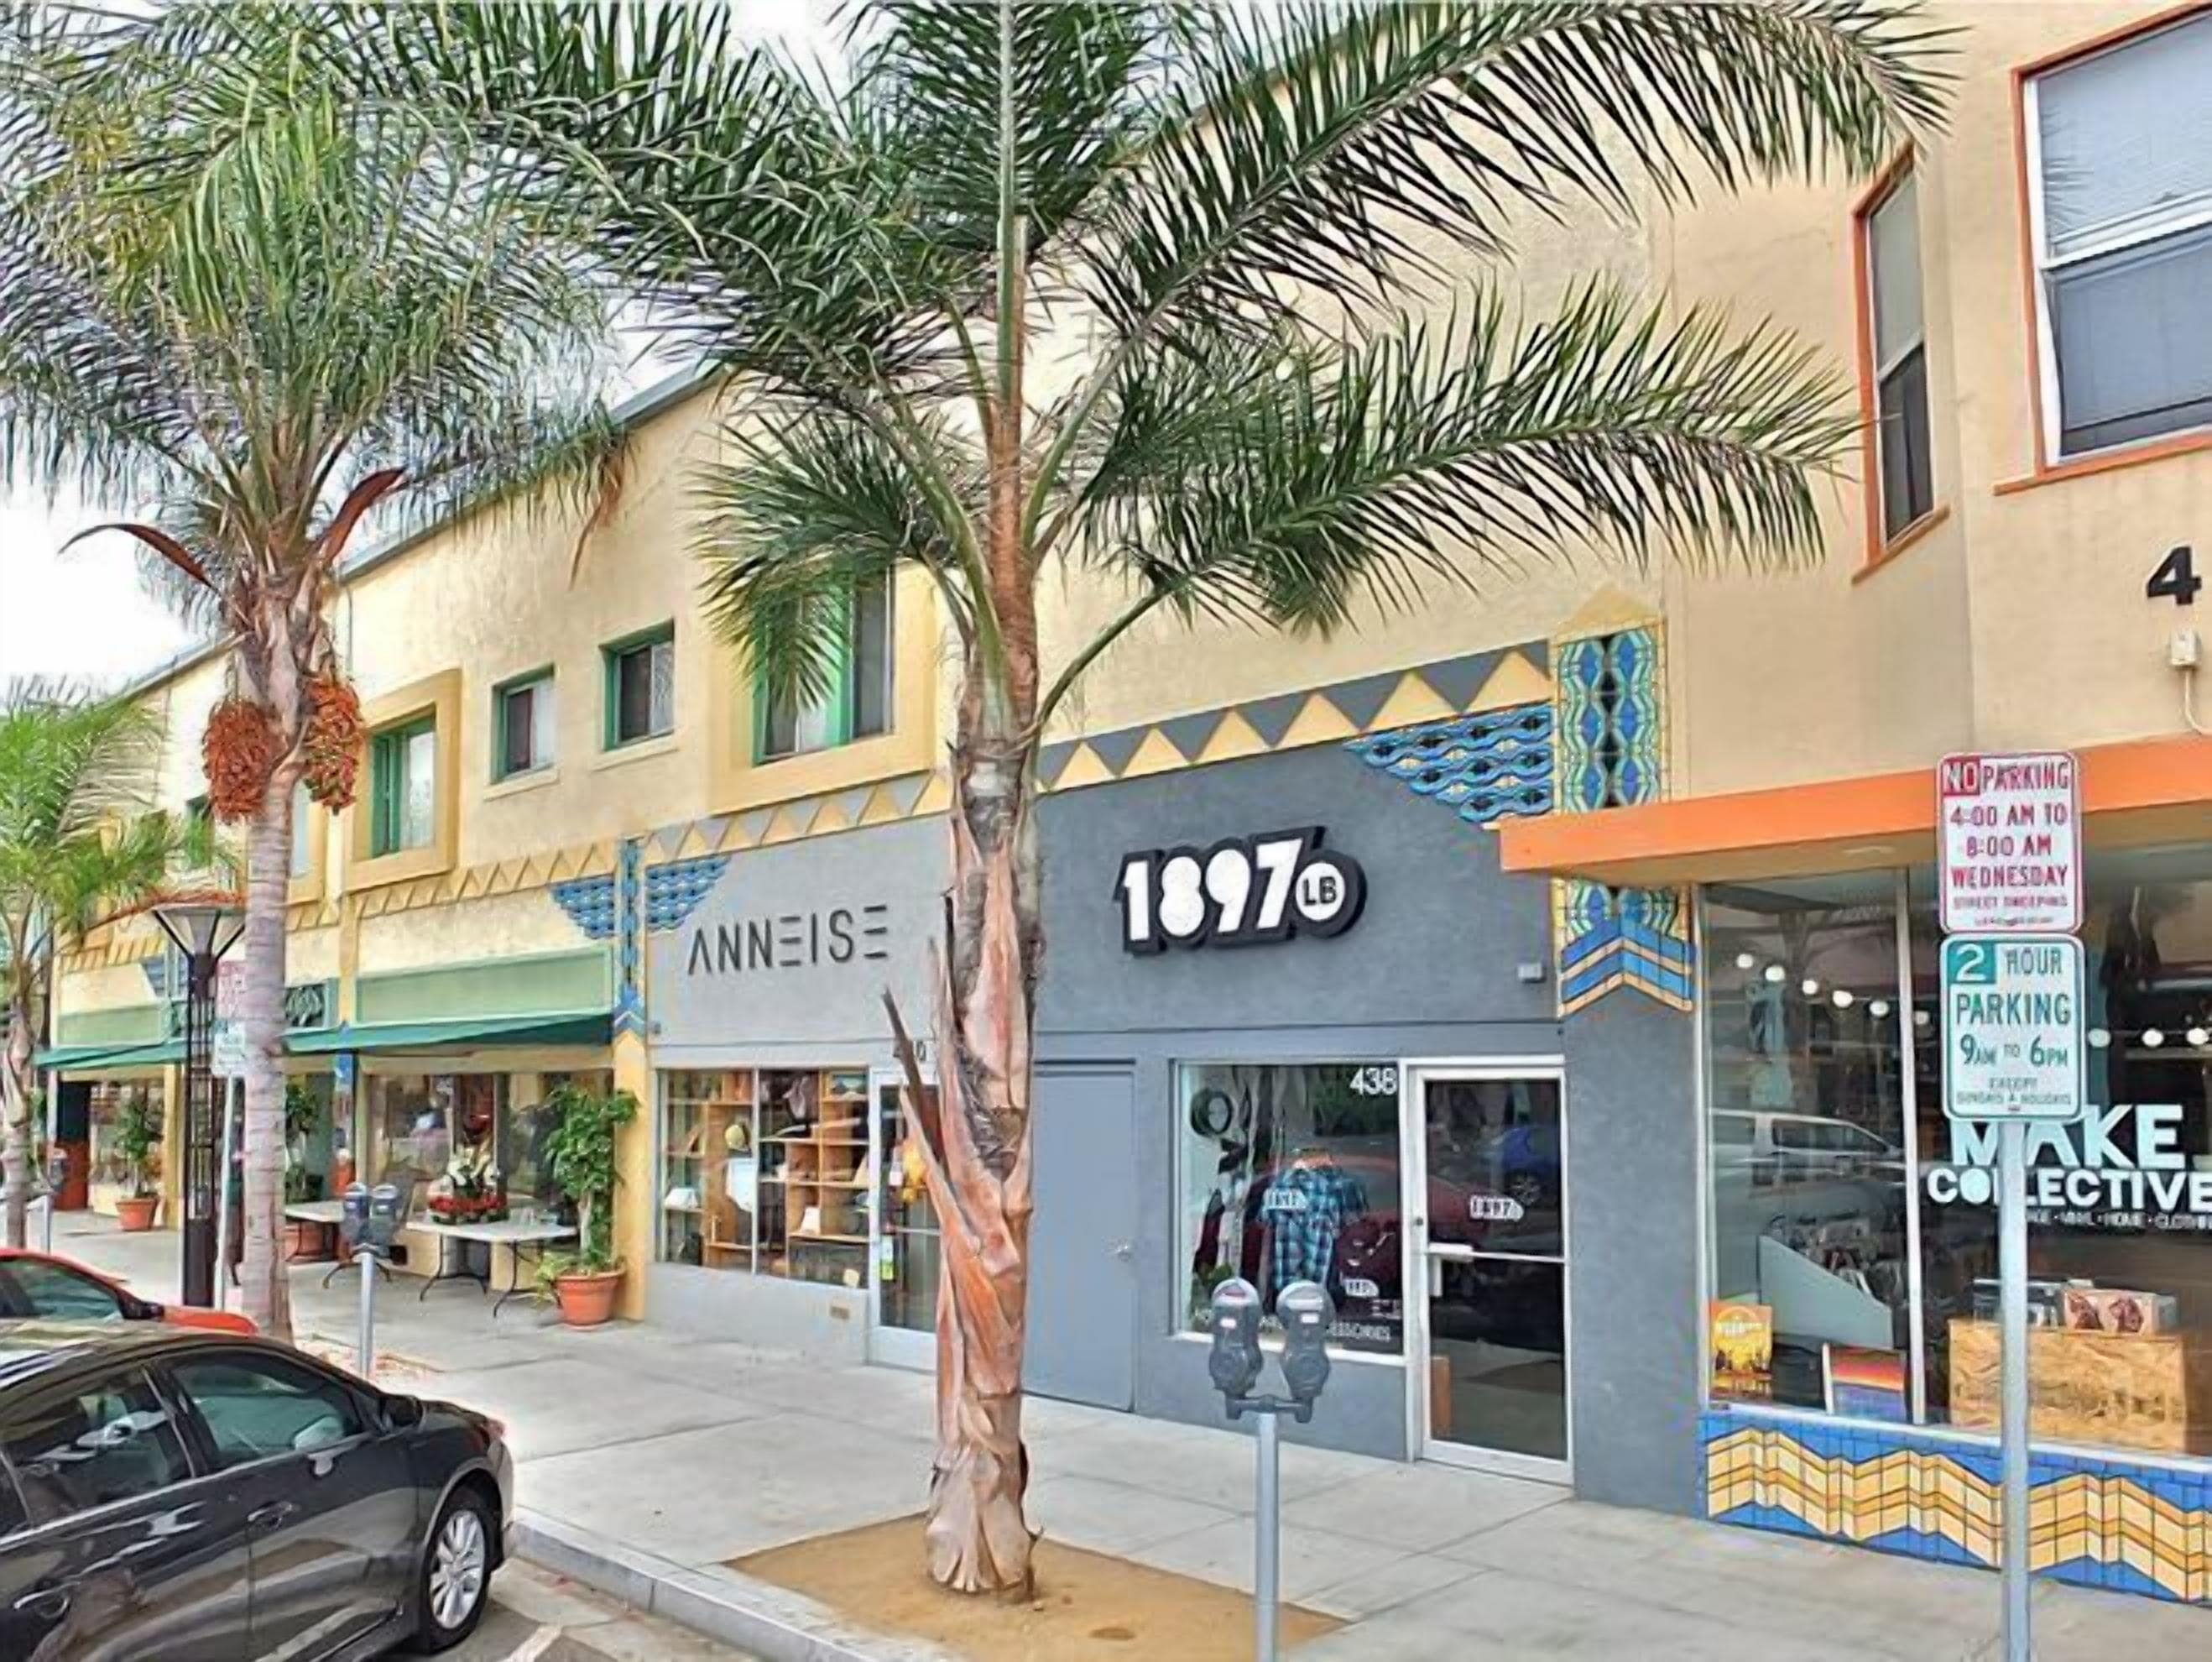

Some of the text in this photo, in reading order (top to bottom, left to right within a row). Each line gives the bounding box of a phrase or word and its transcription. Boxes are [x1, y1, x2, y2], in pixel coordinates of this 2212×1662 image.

[2146, 546, 2202, 605] 4
[1943, 761, 2069, 792] NO PARKING
[1951, 802, 2068, 826] 4:00 AM TO
[1966, 834, 2052, 857] 8:00 AM
[1124, 839, 1337, 941] 1897 LB
[1951, 865, 2068, 888] WEDNESDAY
[688, 905, 888, 975] ANNEISE
[1956, 943, 2061, 981] 2 HOUR
[1956, 992, 2071, 1026] PARKING
[2030, 1035, 2068, 1067] 6PM
[1950, 1105, 2185, 1168] MAKE
[1928, 1168, 2212, 1212] COECTIVE
